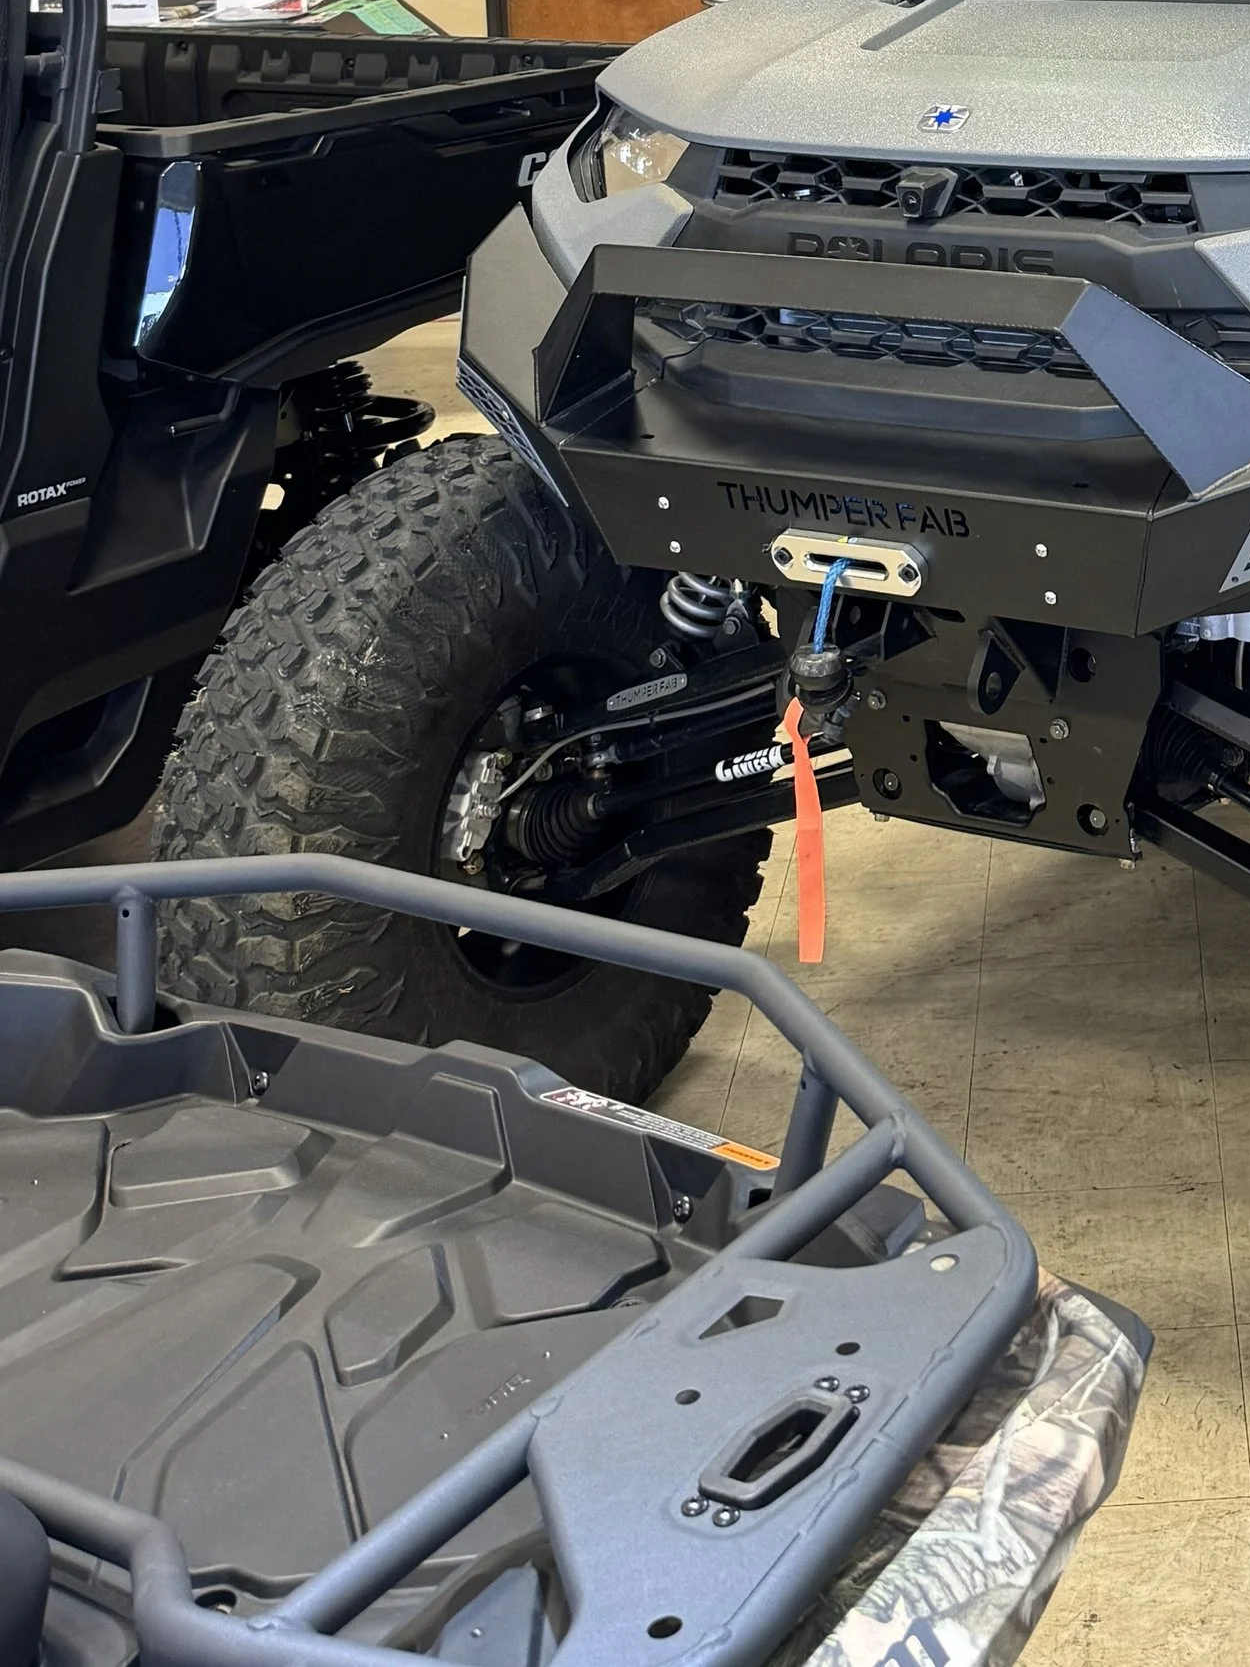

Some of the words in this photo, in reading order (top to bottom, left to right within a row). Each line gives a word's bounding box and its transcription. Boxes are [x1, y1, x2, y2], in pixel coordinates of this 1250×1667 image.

[17, 483, 67, 507] ROTAX
[717, 481, 890, 529] THUMPER
[896, 501, 971, 538] FAB
